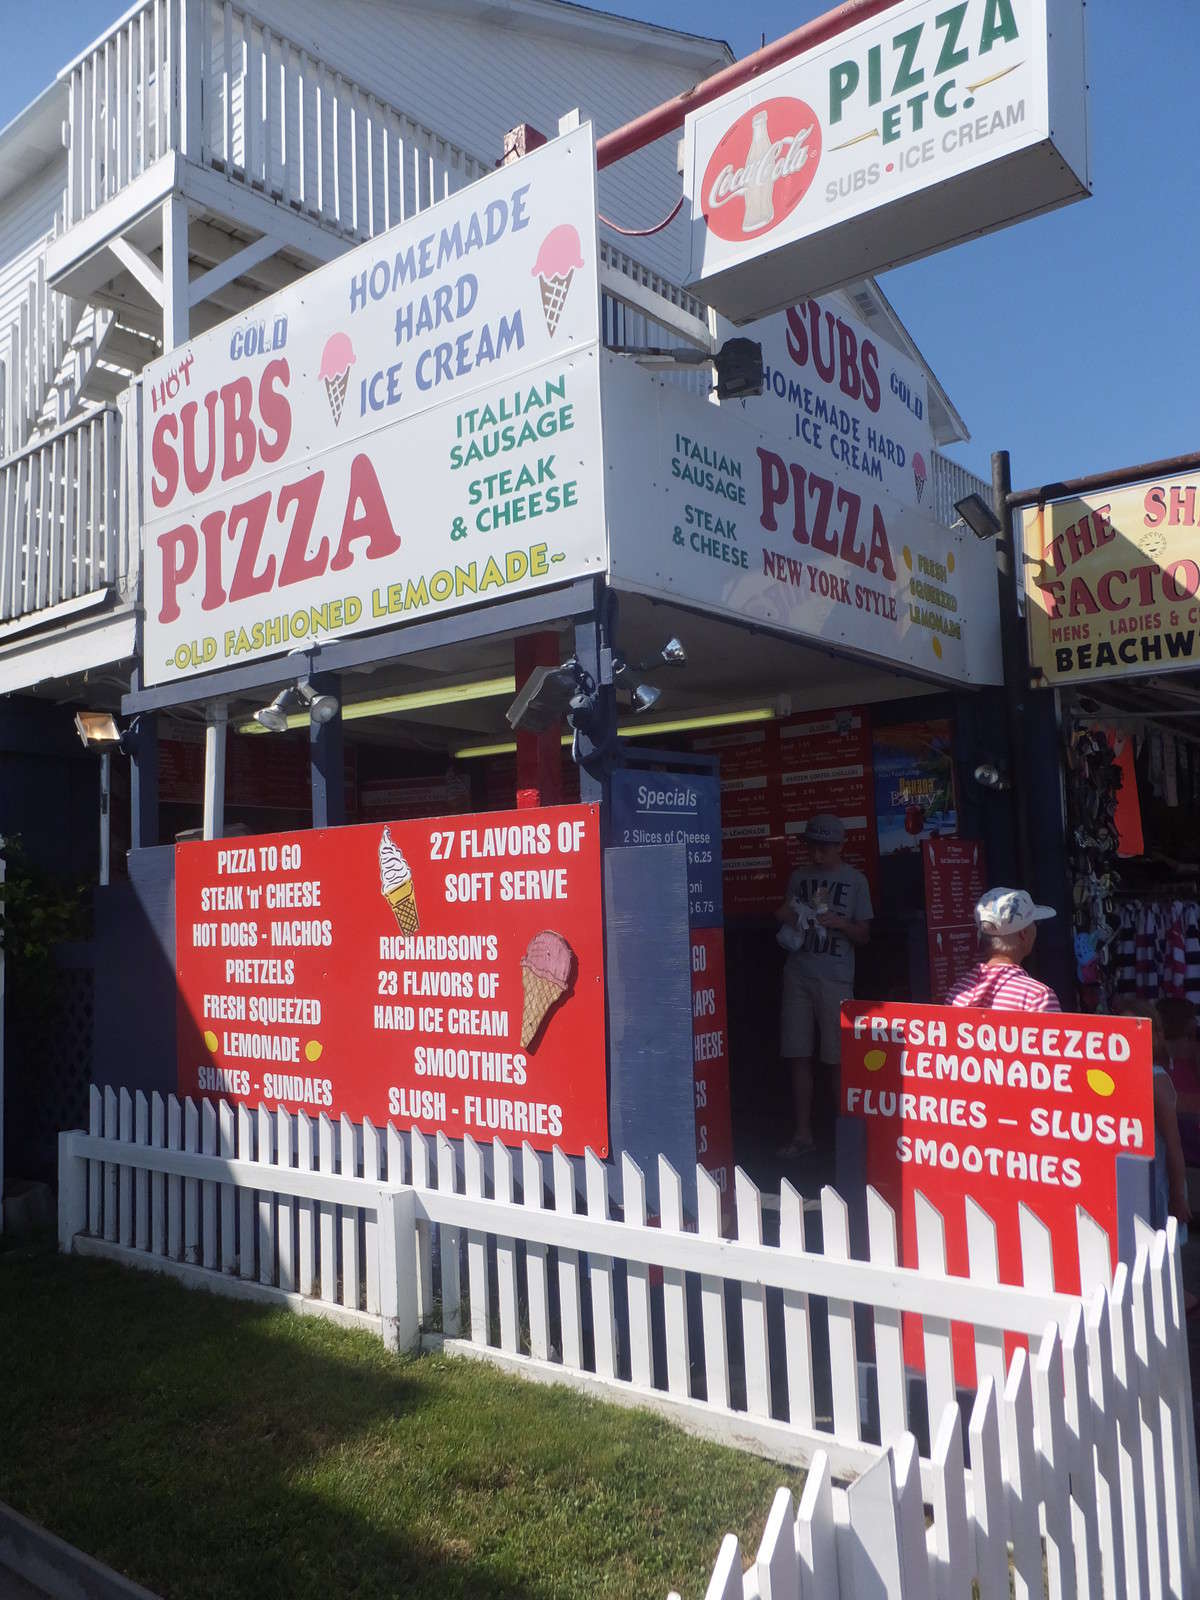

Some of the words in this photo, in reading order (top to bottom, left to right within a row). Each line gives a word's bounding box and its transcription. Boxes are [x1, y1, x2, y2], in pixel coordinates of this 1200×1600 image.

[829, 0, 1019, 125] PIZZA
[882, 79, 975, 146] ETC.
[825, 162, 880, 203] SUBS
[899, 139, 935, 172] ICE
[941, 99, 1026, 153] CREAM
[350, 183, 532, 313] HOMEMADE
[395, 272, 480, 346] HARD
[230, 314, 288, 362] COLD
[786, 297, 881, 413] SUBS
[151, 350, 195, 414] HOT
[360, 360, 403, 418] ICE
[414, 309, 526, 392] CREAM
[455, 375, 566, 439] ITALIAN
[762, 366, 861, 442] HOMEMADE
[867, 427, 906, 467] HARD
[151, 357, 293, 508] SUBS
[449, 404, 575, 471] SAUSAGE
[675, 433, 742, 480] ITALIAN
[795, 413, 822, 449] ICE
[830, 434, 883, 481] CREAM
[467, 455, 557, 506] STEAK
[671, 457, 746, 506] SAUSAGE
[450, 517, 468, 542] &
[476, 481, 579, 534] CHEESE
[684, 504, 737, 541] STEAK
[756, 447, 897, 581] PIZZA
[1044, 504, 1116, 577] THE
[1144, 486, 1200, 528] SH
[157, 453, 401, 624] PIZZA
[672, 526, 685, 547] &
[690, 532, 749, 569] CHEESE
[762, 548, 802, 587] NEW
[807, 559, 851, 606] YORK
[855, 587, 898, 622] STYLE
[224, 596, 363, 655] FASHIONED
[1110, 612, 1161, 636] LADIES
[1169, 610, 1179, 627] &
[1055, 629, 1200, 672] BEACHW
[637, 785, 697, 808] Specials
[217, 846, 256, 875] PIZZA
[259, 846, 279, 872] TO
[281, 844, 302, 870] GO
[430, 829, 457, 861] 27
[460, 824, 552, 859] FLAVORS
[556, 821, 586, 853] OF
[624, 830, 630, 843] 2
[632, 830, 662, 845] Slices
[664, 830, 675, 844] of
[676, 830, 711, 845] Cheese
[201, 885, 244, 912] STEAK
[265, 881, 321, 909] CHEESE
[445, 871, 494, 903] SOFT
[499, 868, 568, 901] SERVE
[192, 922, 219, 948] HOT
[221, 922, 258, 948] DOGS
[271, 919, 333, 947] NACHOS
[379, 934, 498, 962] RICHARDSON'S
[225, 959, 295, 986] PRETZELS
[378, 971, 399, 996] 23
[403, 972, 473, 998] FLAVORS
[476, 972, 500, 999] OF
[203, 994, 246, 1021] FRESH
[249, 997, 322, 1026] SQUEEZED
[373, 1005, 415, 1033] HARD
[418, 1008, 444, 1034] ICE
[447, 1009, 509, 1038] CREAM
[693, 989, 715, 1017] APS
[223, 1031, 301, 1063] LEMONADE
[695, 1031, 724, 1061] HEESE
[854, 1015, 947, 1047] FRESH
[956, 1022, 1131, 1062] SQUEEZED
[197, 1066, 251, 1096] SHAKES
[263, 1074, 333, 1106] SUNDAES
[413, 1046, 527, 1086] SMOOTHIES
[900, 1050, 1073, 1094] LEMONADE
[388, 1086, 446, 1122] SLUSH
[464, 1095, 563, 1137] FLURRIES
[846, 1087, 987, 1129] FLURRIES
[1029, 1107, 1144, 1148] SLUSH
[895, 1136, 1082, 1188] SMOOTHIES
